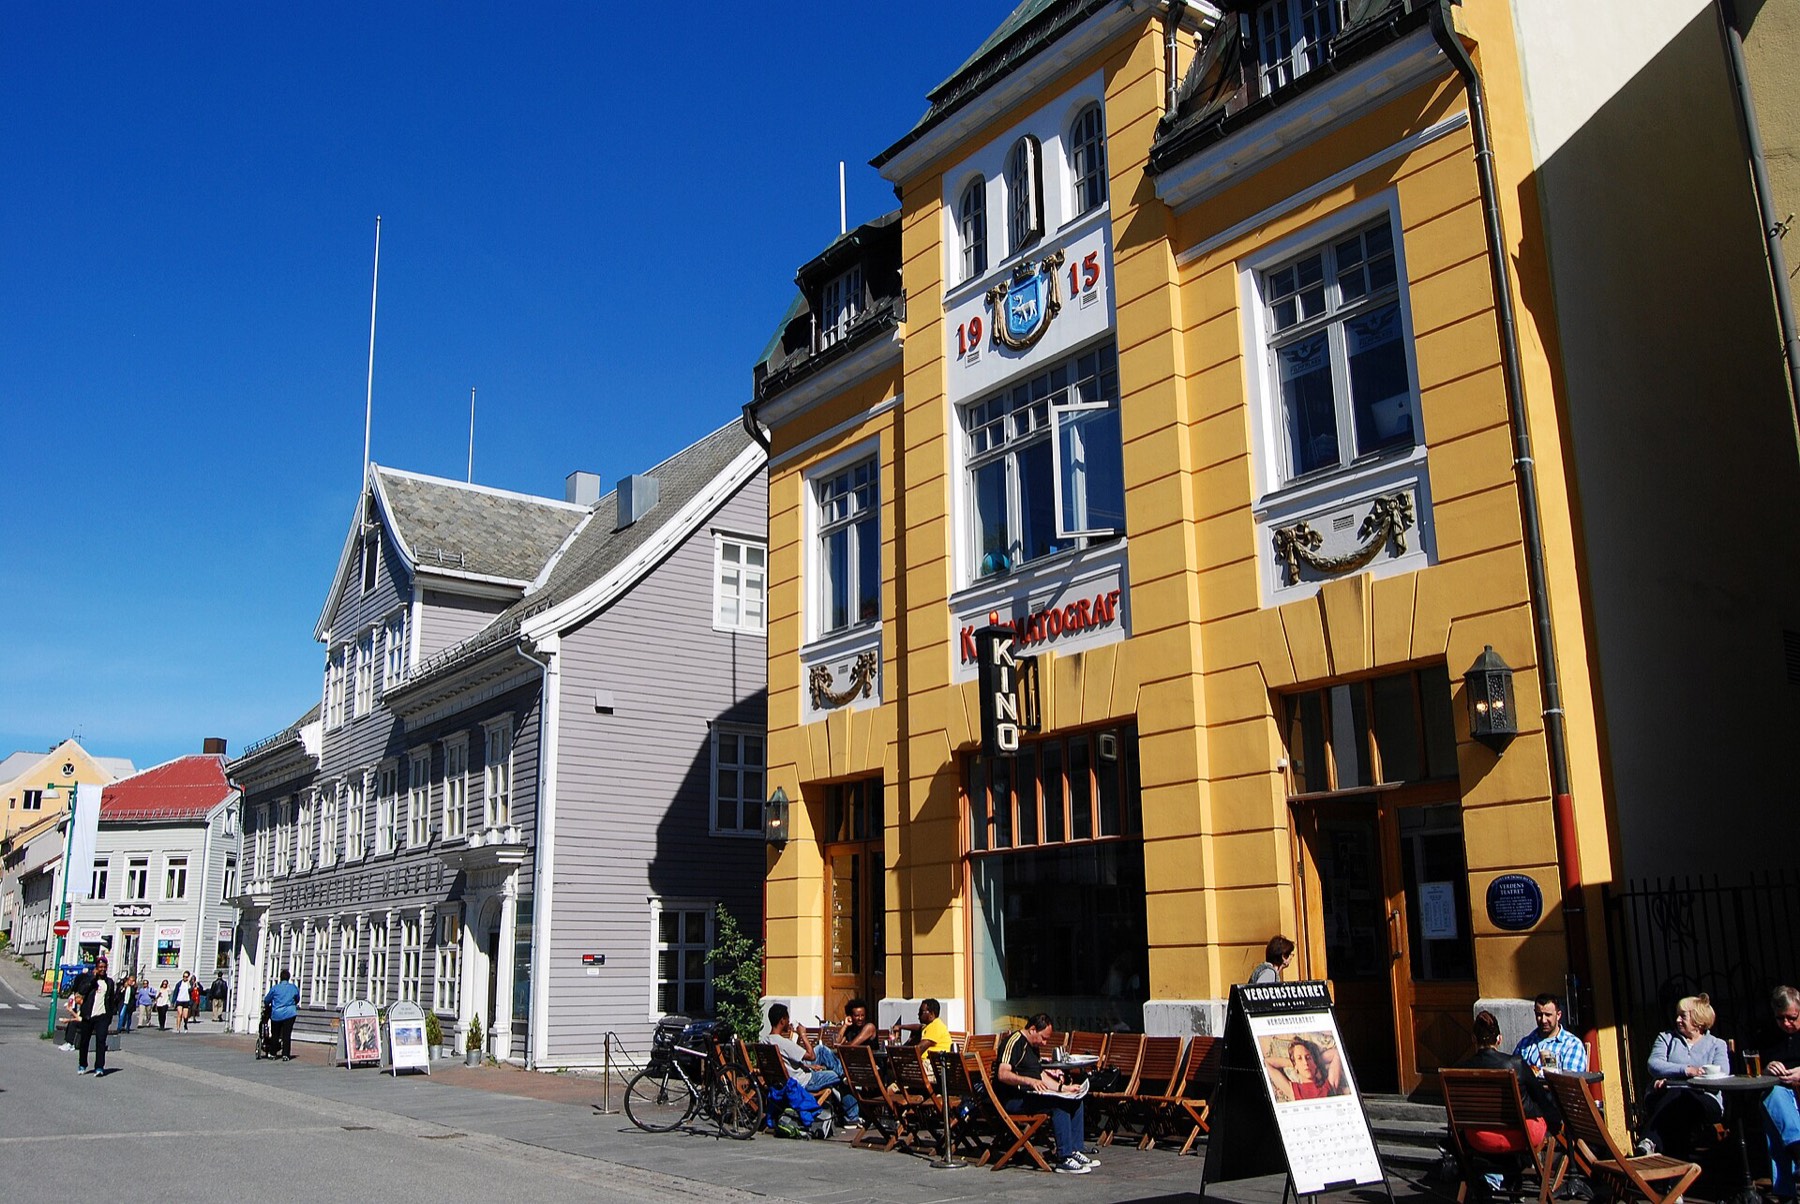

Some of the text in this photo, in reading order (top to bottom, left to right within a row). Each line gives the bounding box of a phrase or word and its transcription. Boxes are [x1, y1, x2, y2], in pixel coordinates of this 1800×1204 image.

[956, 250, 1101, 355] 19 15
[960, 589, 1121, 664] KMATOGRAF
[993, 637, 1019, 752] KINO
[282, 861, 444, 911] PERSPEKTIVET MUSEUM
[1243, 984, 1325, 1001] VERDENSTEATRET
[1266, 1016, 1316, 1027] VERDENSTEATRET
